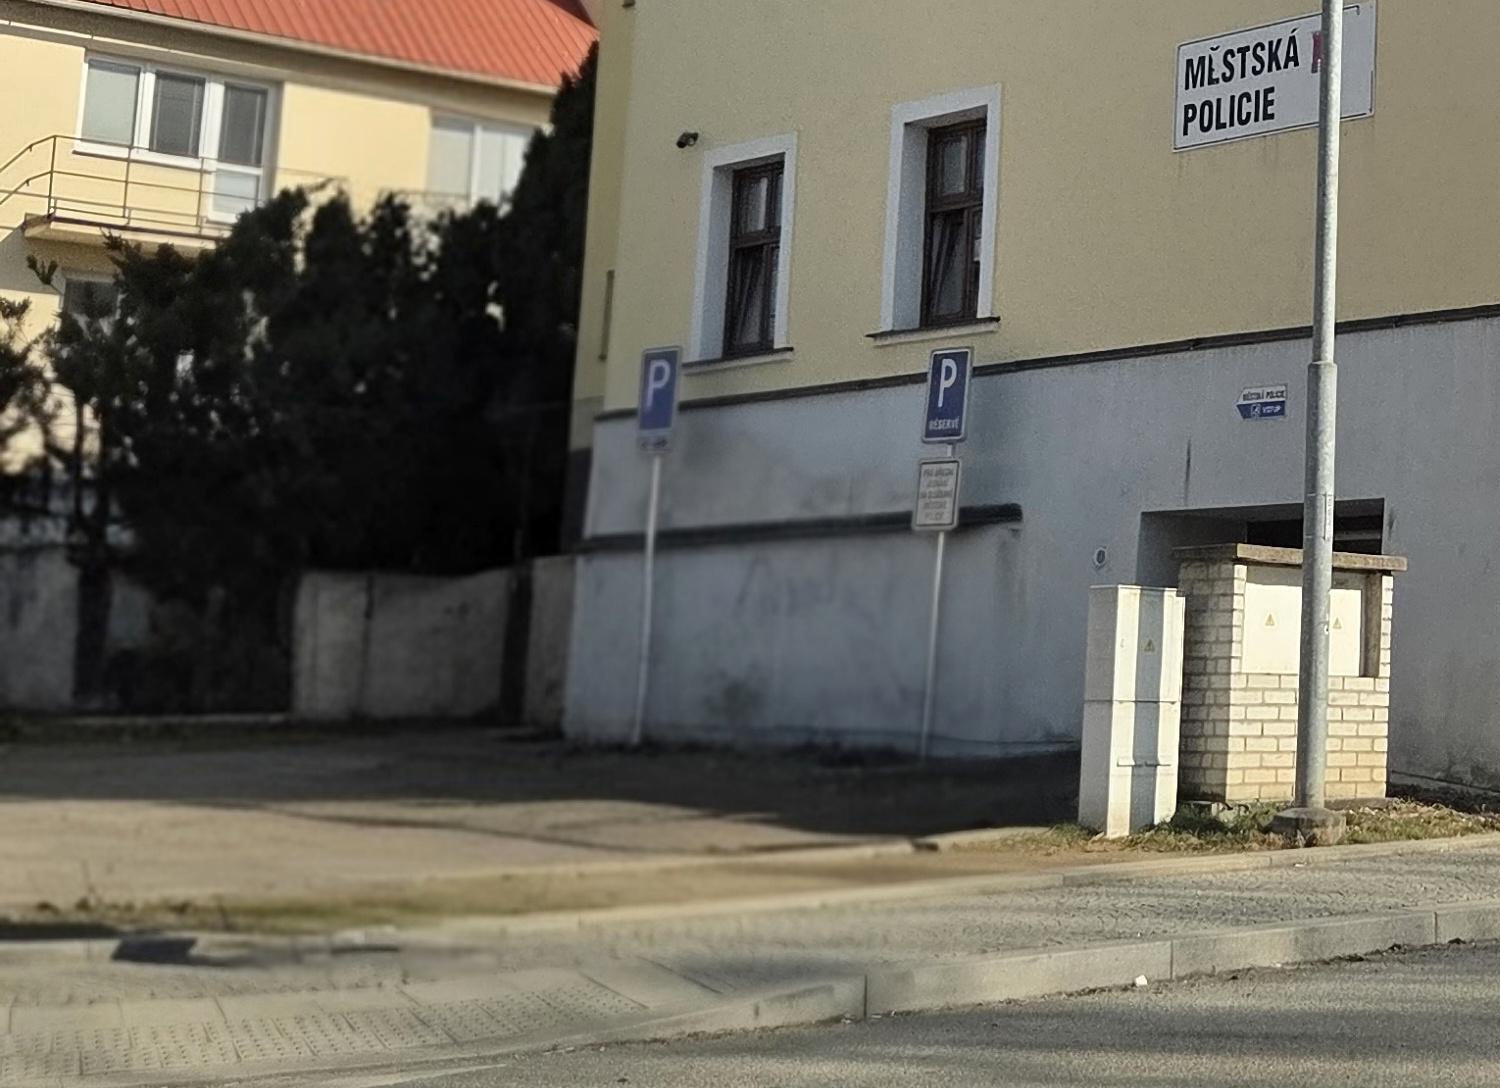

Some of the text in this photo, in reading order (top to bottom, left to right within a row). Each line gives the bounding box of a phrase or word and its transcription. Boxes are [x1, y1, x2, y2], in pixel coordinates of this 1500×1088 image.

[1182, 86, 1275, 136] POLICIE
[646, 359, 671, 408] P
[937, 358, 958, 408] P
